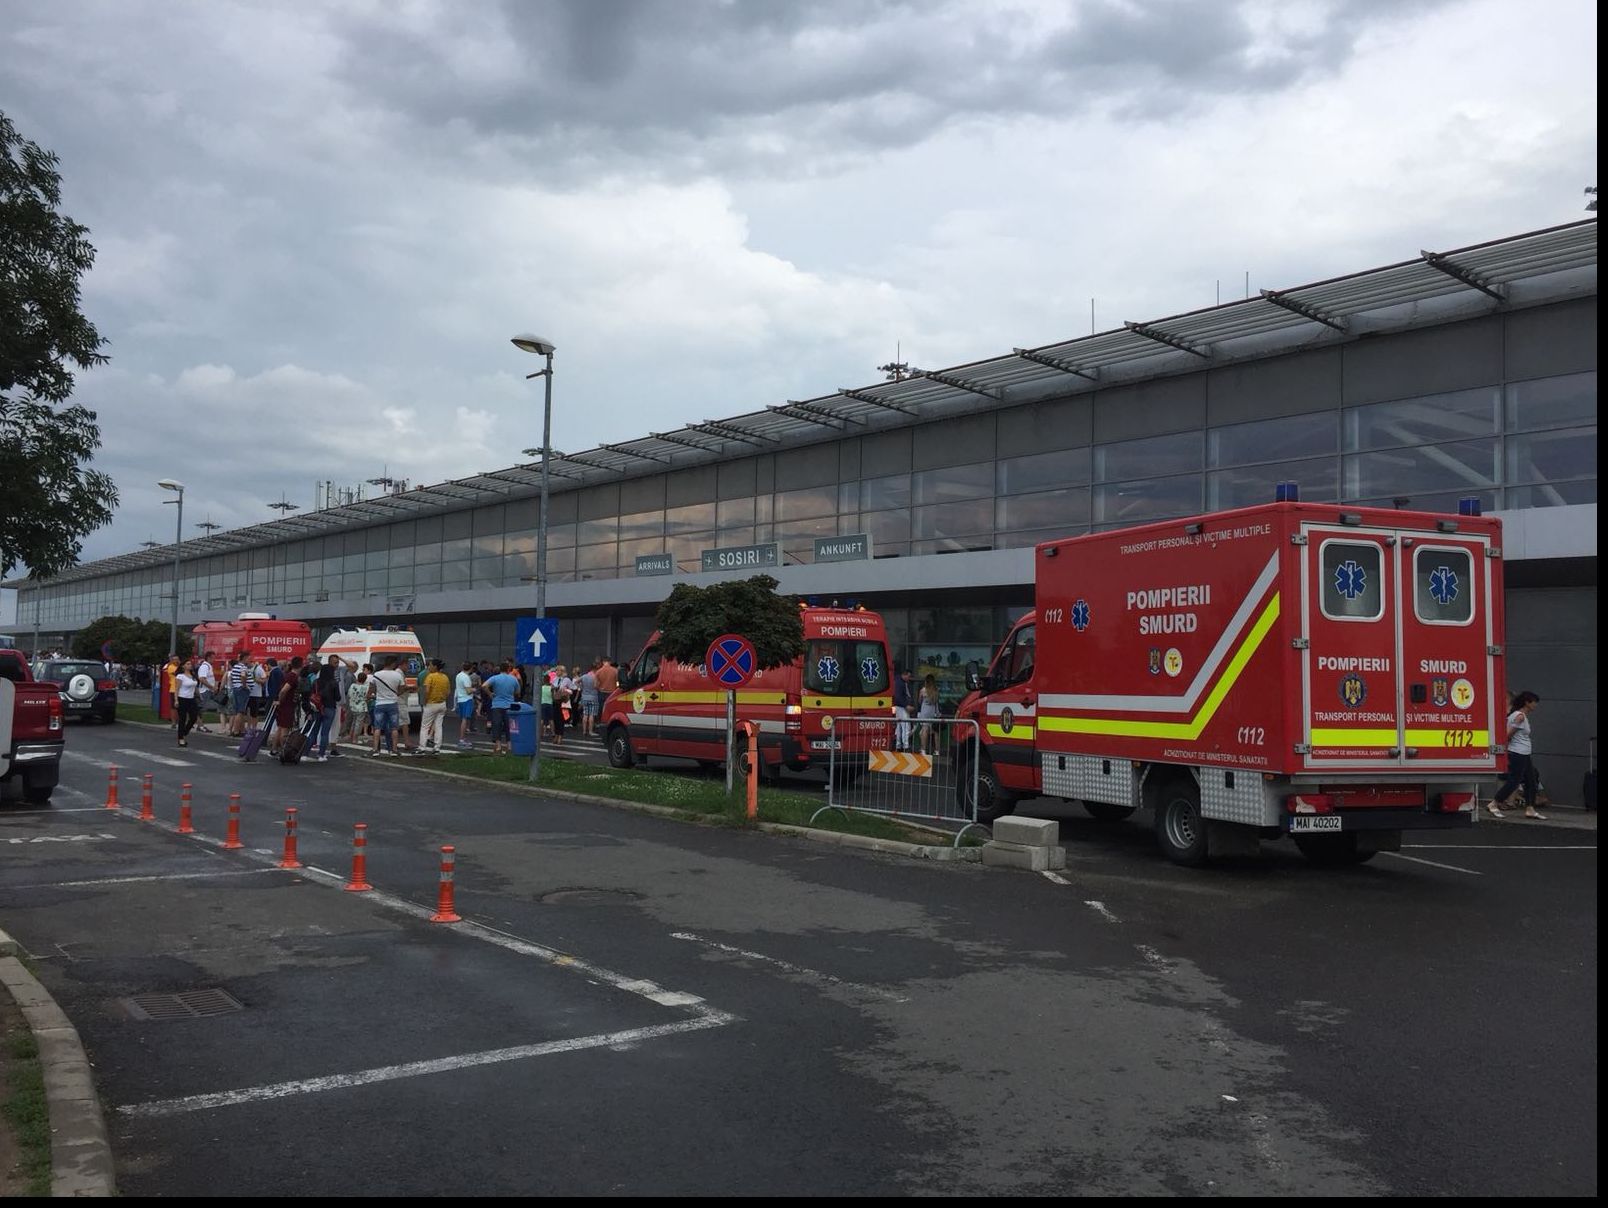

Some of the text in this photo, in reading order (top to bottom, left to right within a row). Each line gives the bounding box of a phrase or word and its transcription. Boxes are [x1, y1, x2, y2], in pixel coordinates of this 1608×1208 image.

[1120, 541, 1157, 555] TRANSPORT
[1157, 537, 1194, 550] PERSONAL
[1203, 531, 1233, 543] VICTIME
[1233, 524, 1271, 538] MULTIPLE
[820, 542, 862, 555] ANKUNFT
[719, 550, 760, 567] SOSIRI
[638, 560, 670, 571] ARRIVALS
[1127, 585, 1211, 610] POMPIERII
[1139, 613, 1198, 635] SMURD
[821, 626, 867, 637] POMPIERII
[252, 636, 306, 646] POMPIERII
[1318, 656, 1390, 672] POMPIERII
[1420, 659, 1467, 674] SMURD
[1315, 711, 1395, 723] TRANSPORT PERSONAL
[1414, 713, 1440, 723] VICTIME
[1441, 713, 1472, 723] MULTIPLE
[860, 721, 886, 730] SMURD
[1296, 817, 1339, 829] MAI 40202
